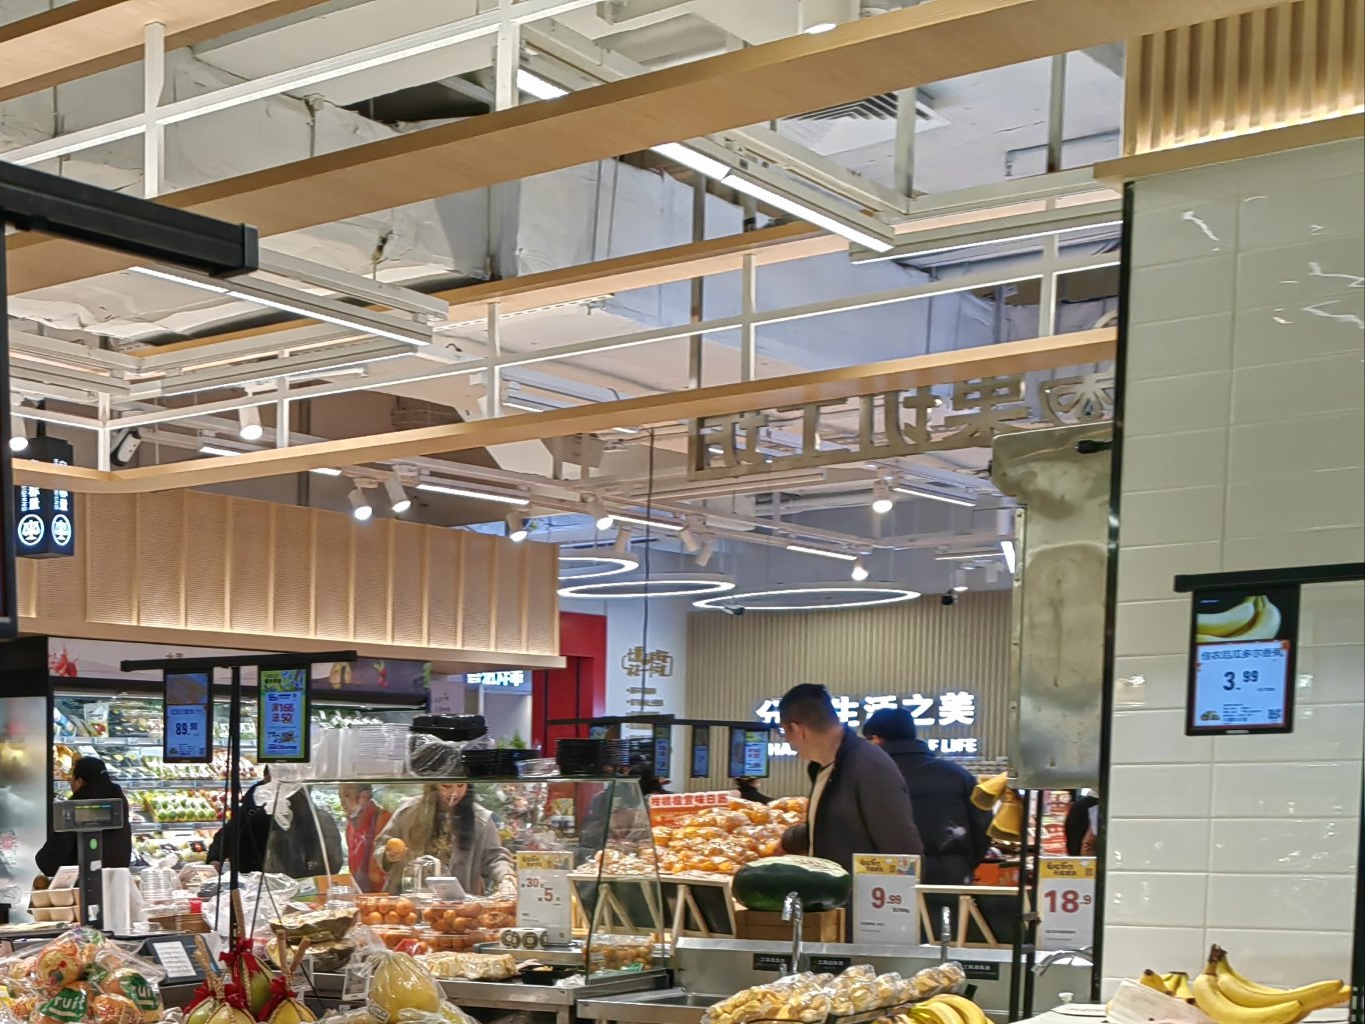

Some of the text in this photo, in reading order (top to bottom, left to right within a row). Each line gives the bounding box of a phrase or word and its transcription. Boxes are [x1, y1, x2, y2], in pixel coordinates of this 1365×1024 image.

[1223, 670, 1260, 692] 3.99
[755, 691, 976, 729] 分生活之美
[940, 738, 978, 753] LIFE
[871, 886, 903, 909] 9.99
